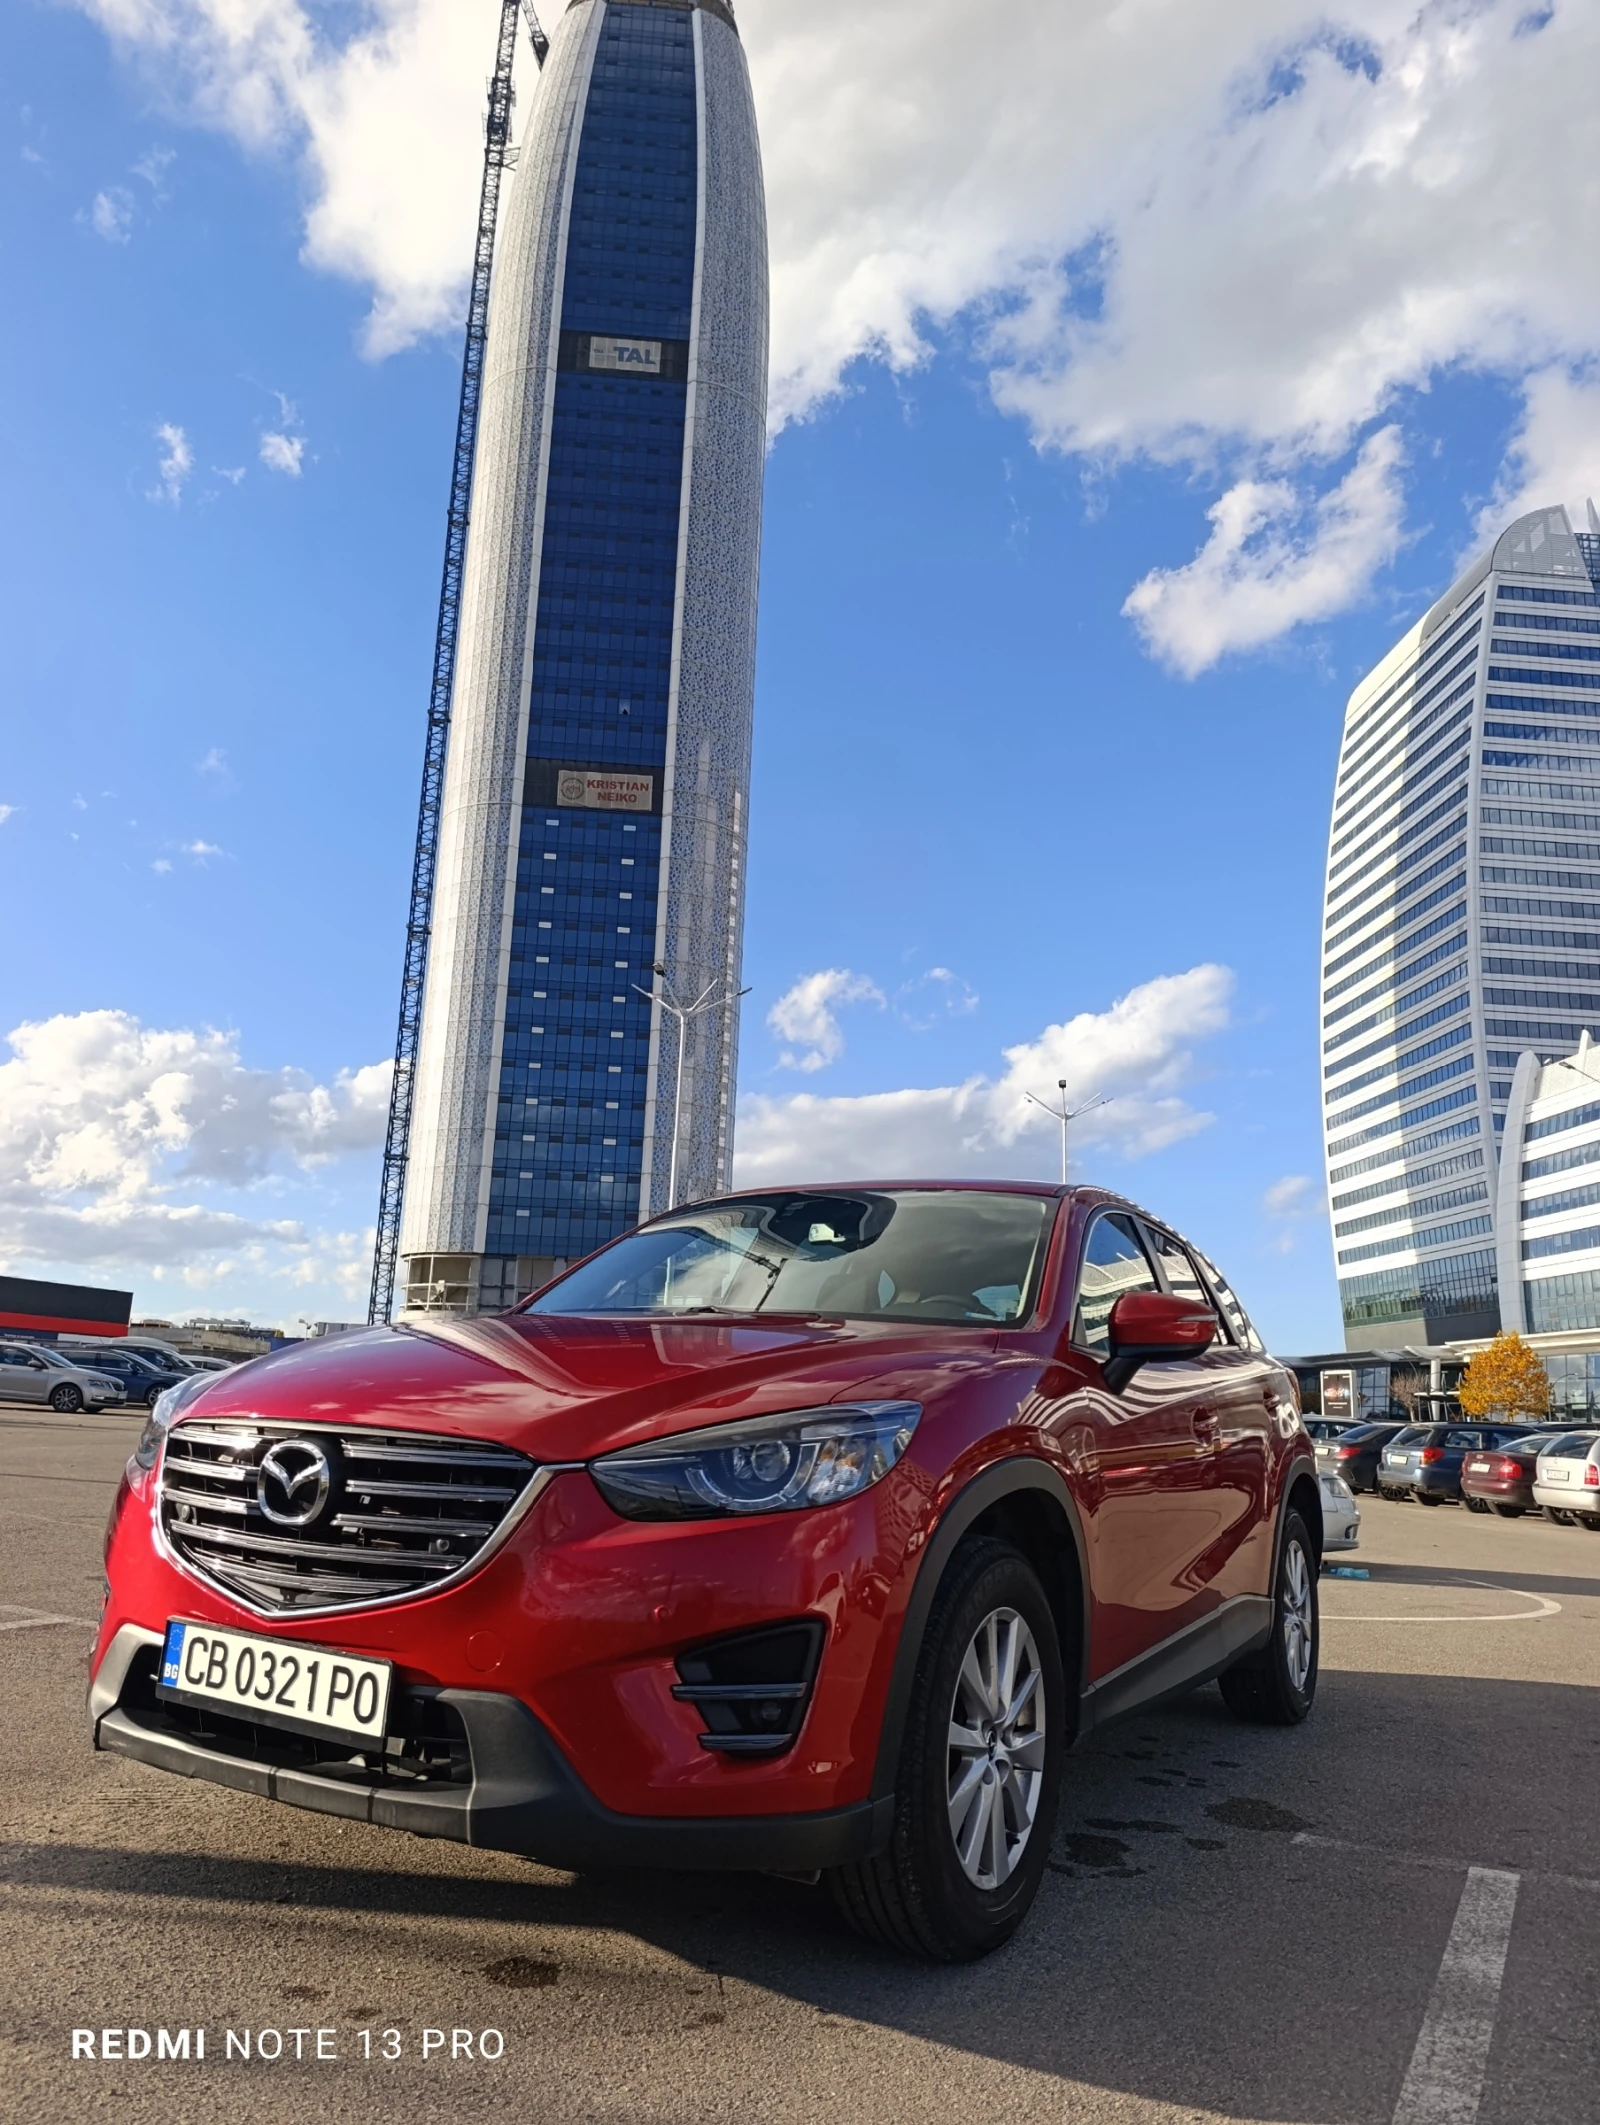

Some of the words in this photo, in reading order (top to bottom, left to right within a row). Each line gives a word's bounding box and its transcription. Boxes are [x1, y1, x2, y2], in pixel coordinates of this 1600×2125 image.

[613, 347, 656, 365] TAL
[587, 779, 649, 791] KRISTIAN
[598, 792, 637, 803] NEIKO
[164, 1663, 179, 1679] BG
[185, 1637, 229, 1689] CB
[235, 1647, 320, 1712] 0321
